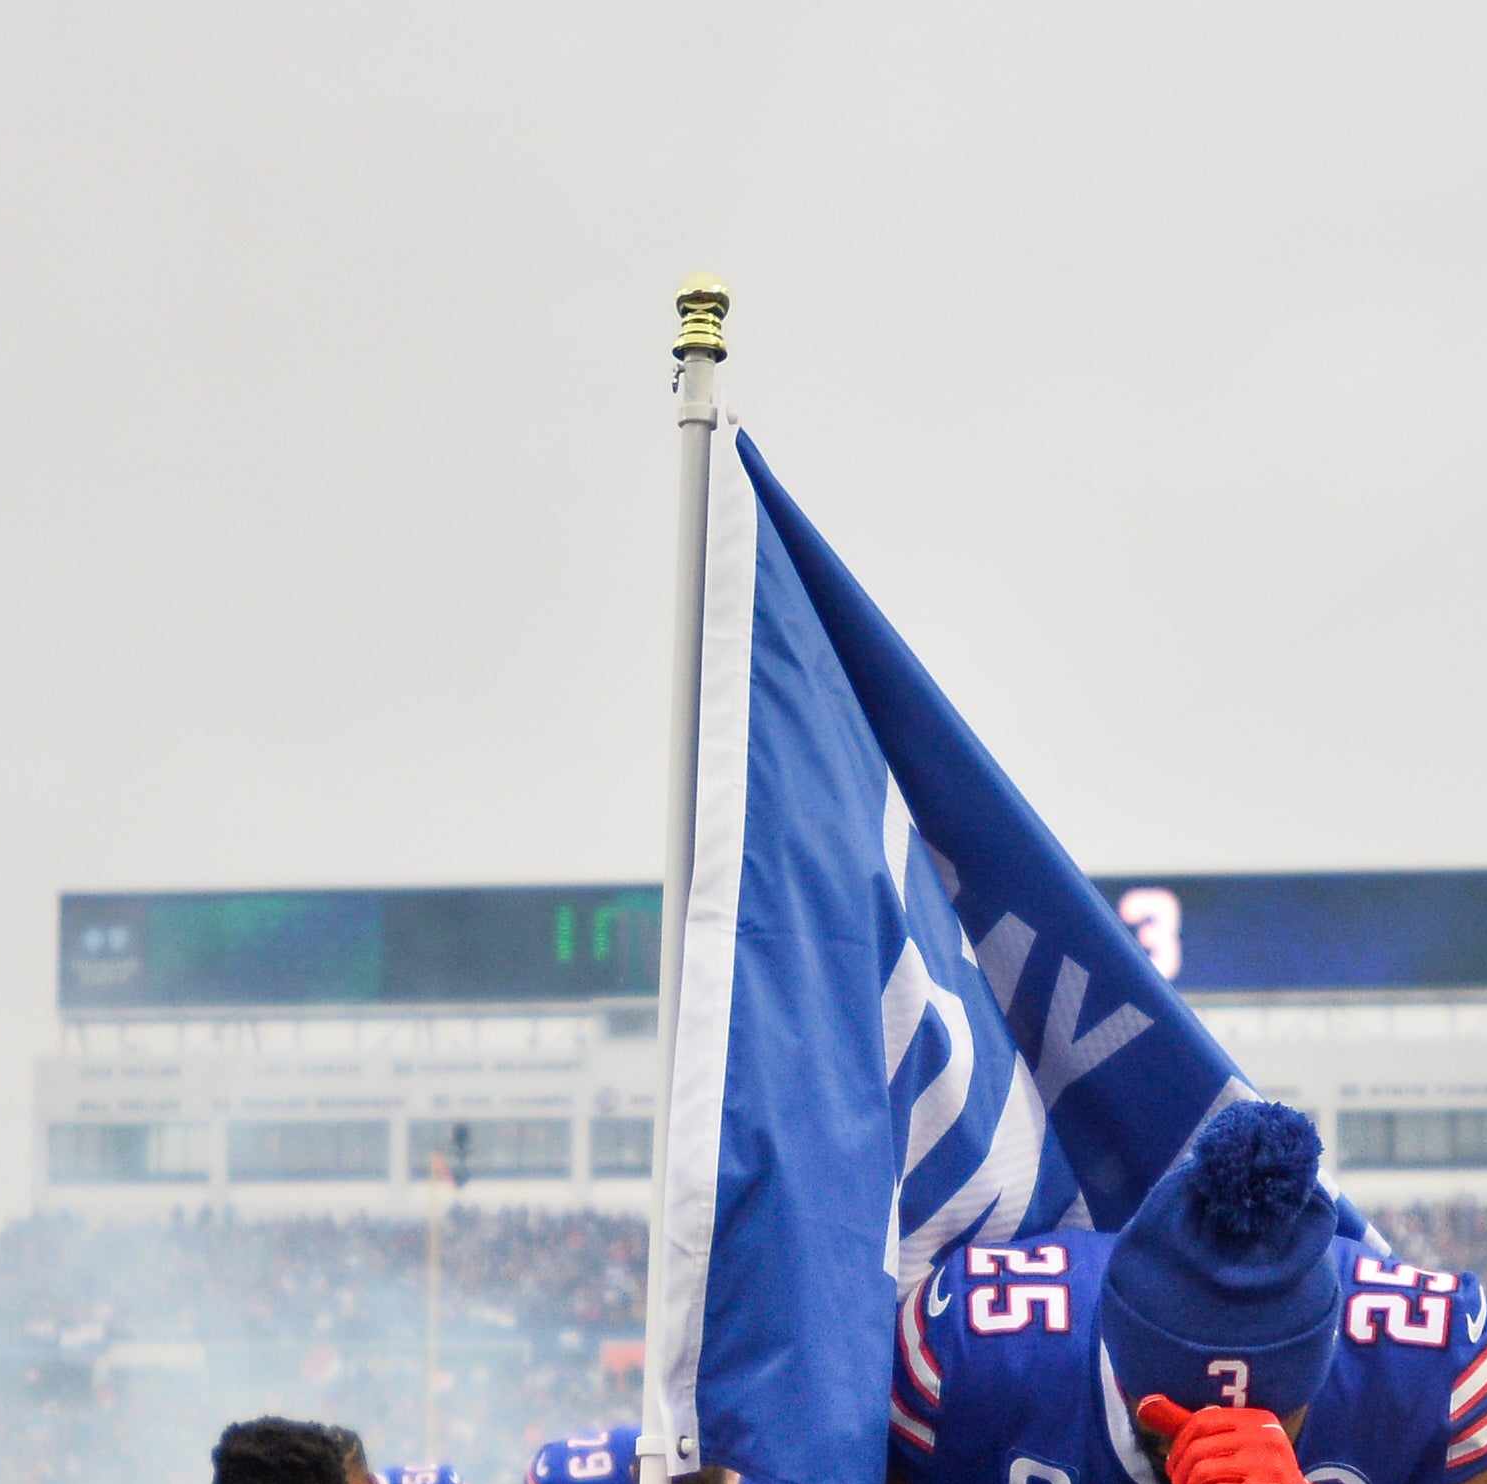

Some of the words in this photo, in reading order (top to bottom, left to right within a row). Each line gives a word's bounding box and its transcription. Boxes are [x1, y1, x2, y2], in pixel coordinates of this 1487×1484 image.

[1118, 887, 1183, 983] 3
[968, 1245, 1069, 1335] 25
[1346, 1256, 1459, 1348] 25
[1207, 1358, 1250, 1408] 3
